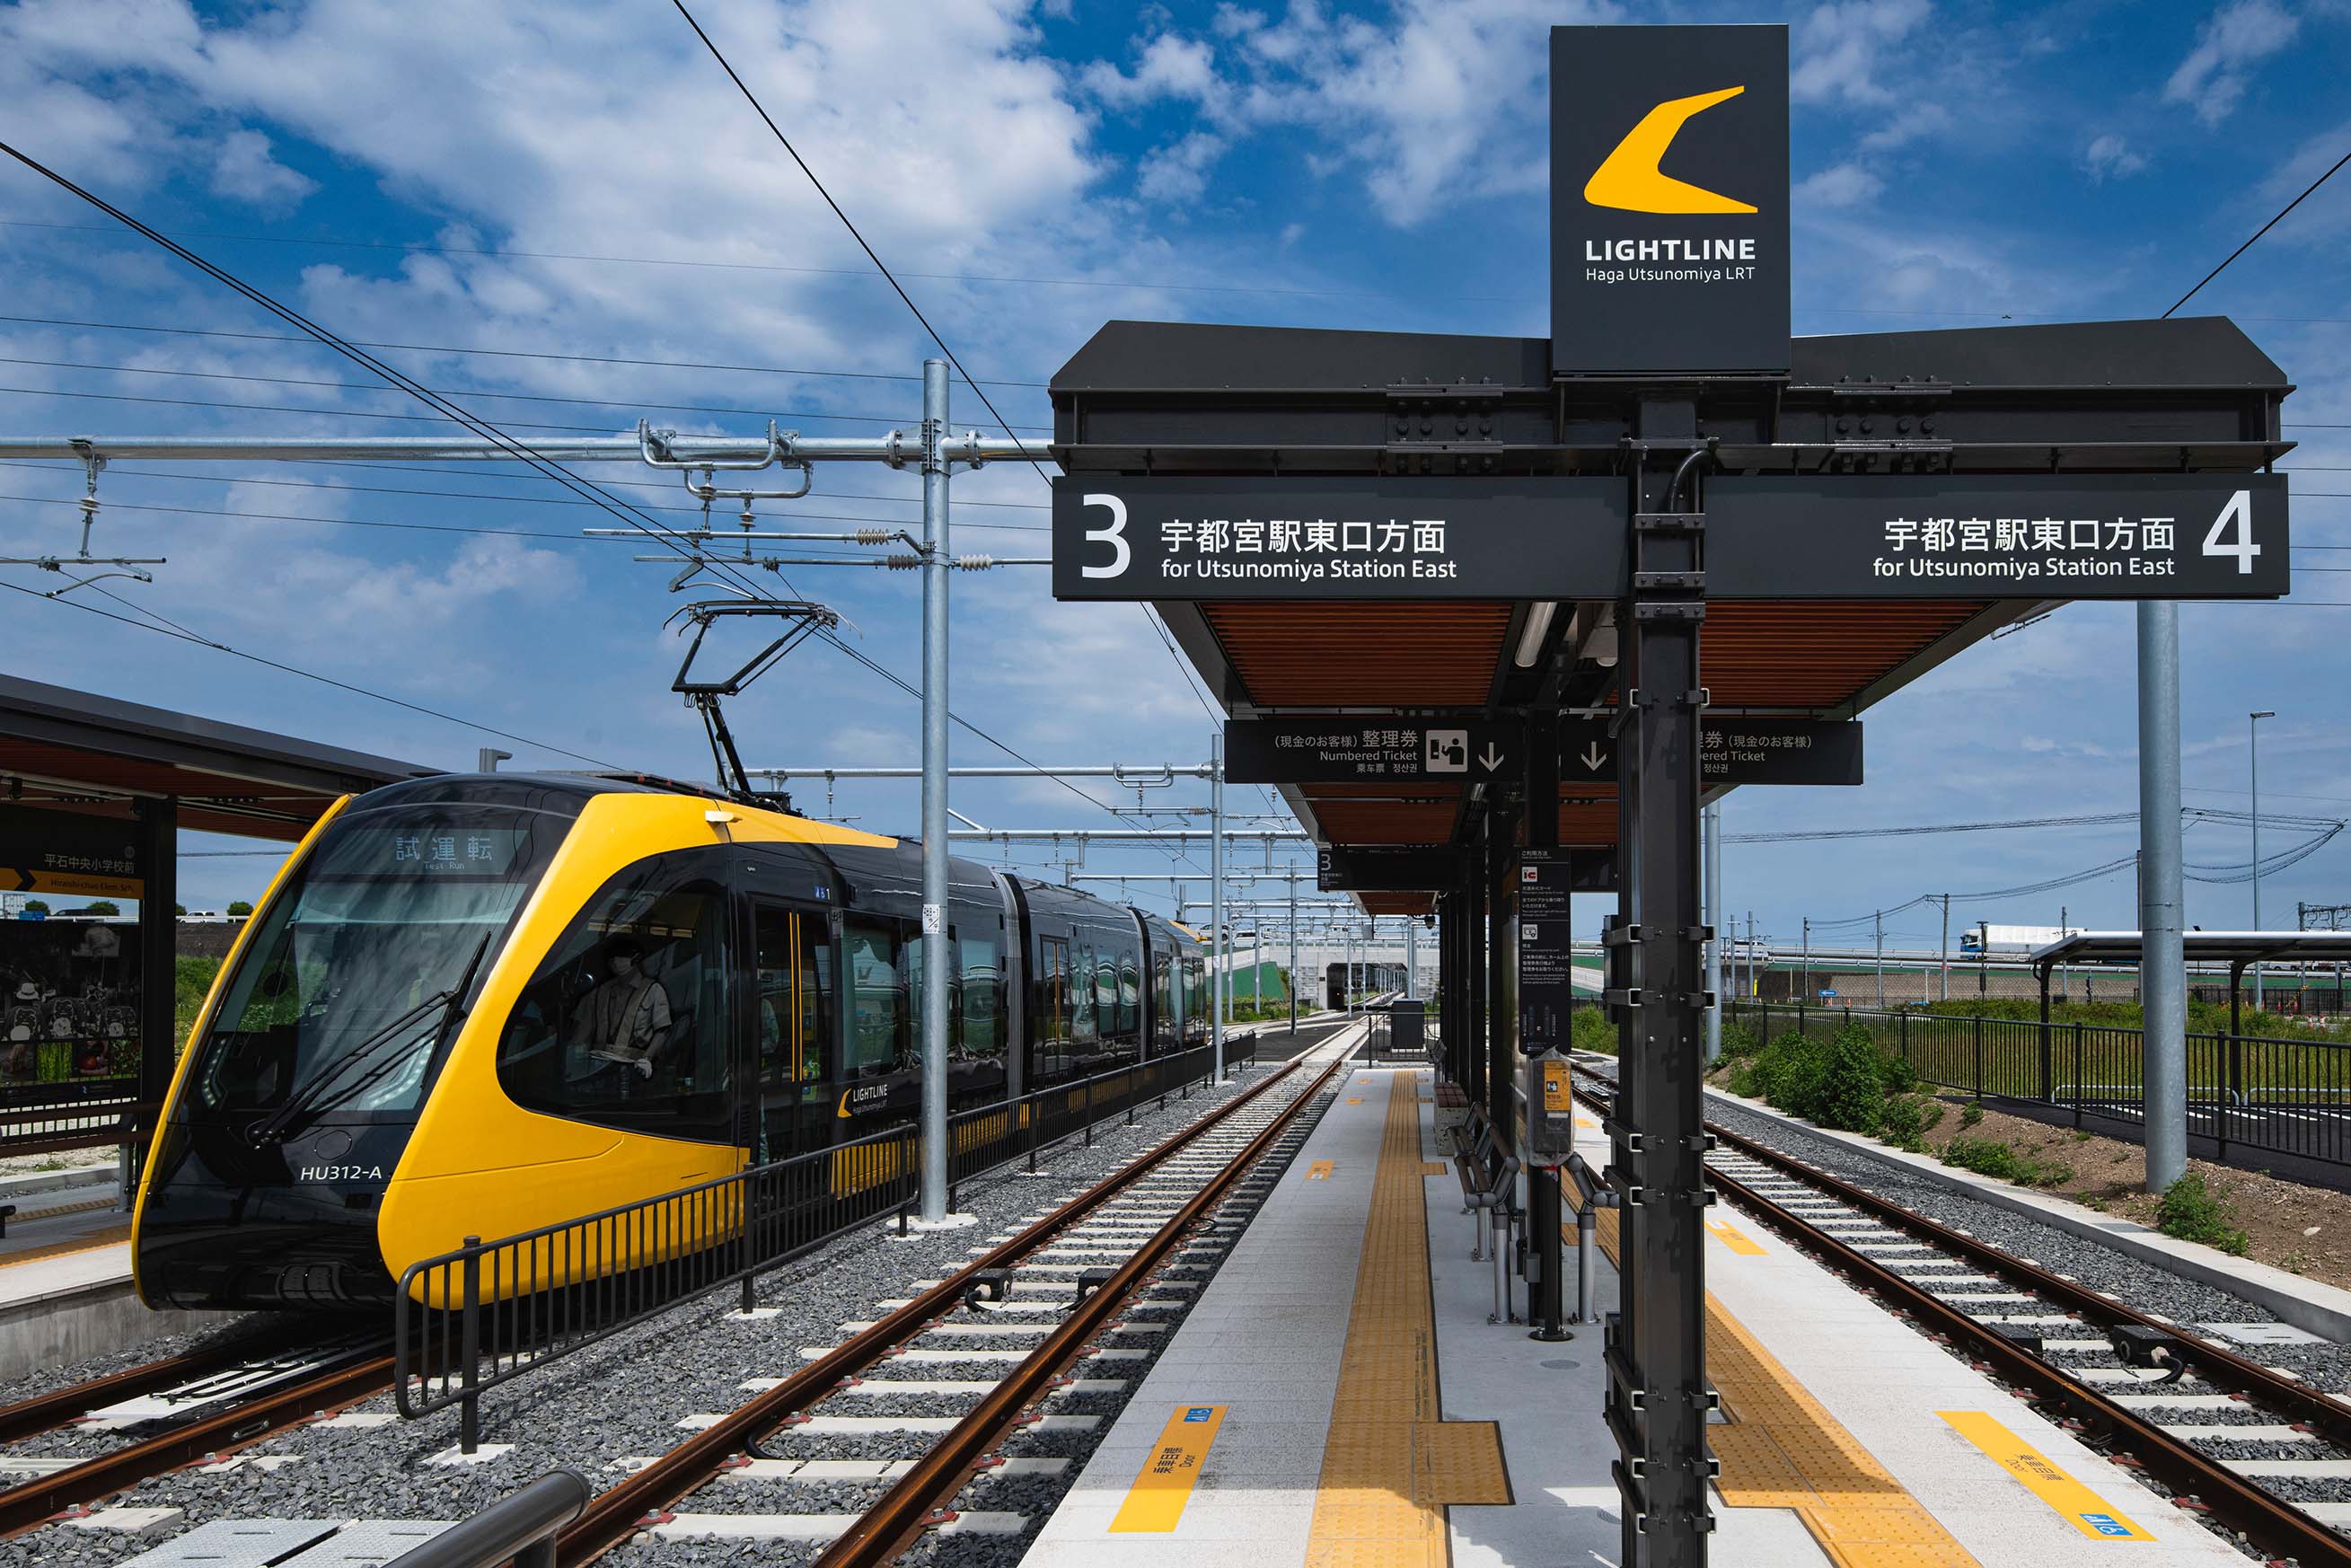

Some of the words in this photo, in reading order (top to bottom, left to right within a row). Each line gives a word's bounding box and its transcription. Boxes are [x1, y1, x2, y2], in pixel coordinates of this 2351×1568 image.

[1586, 238, 1756, 261] LIGHTLINE
[1586, 268, 1625, 285] Haga
[1628, 266, 1721, 284] Utsunomiya
[1726, 266, 1756, 280] LRT
[1081, 493, 1131, 579] 3
[1160, 518, 1446, 554] 宇都宮駅東口方面
[1884, 516, 2175, 552] 宇都宮駅東口方面
[2202, 489, 2261, 575] 4
[1160, 558, 1192, 578] for
[1197, 558, 1325, 583] Utsunomiya
[1330, 558, 1405, 578] Station
[1412, 559, 1457, 578] East
[1872, 557, 1905, 577] for
[1909, 557, 2039, 581] Utsunomiya
[2046, 557, 2122, 577] Station
[2129, 557, 2176, 576] East
[1362, 729, 1418, 748] 整理券
[1320, 750, 1380, 762] Numbered
[1382, 750, 1418, 761] Ticket
[1730, 750, 1765, 762] Ticket
[395, 836, 493, 861] 試運転
[43, 853, 136, 875] 平石中央小学校前
[423, 861, 444, 870] Test
[449, 861, 465, 870] Run
[1320, 853, 1332, 871] 3
[852, 1084, 888, 1103] LIGHTLINE
[300, 1166, 382, 1181] HU312-A
[1179, 1454, 1195, 1467] Door
